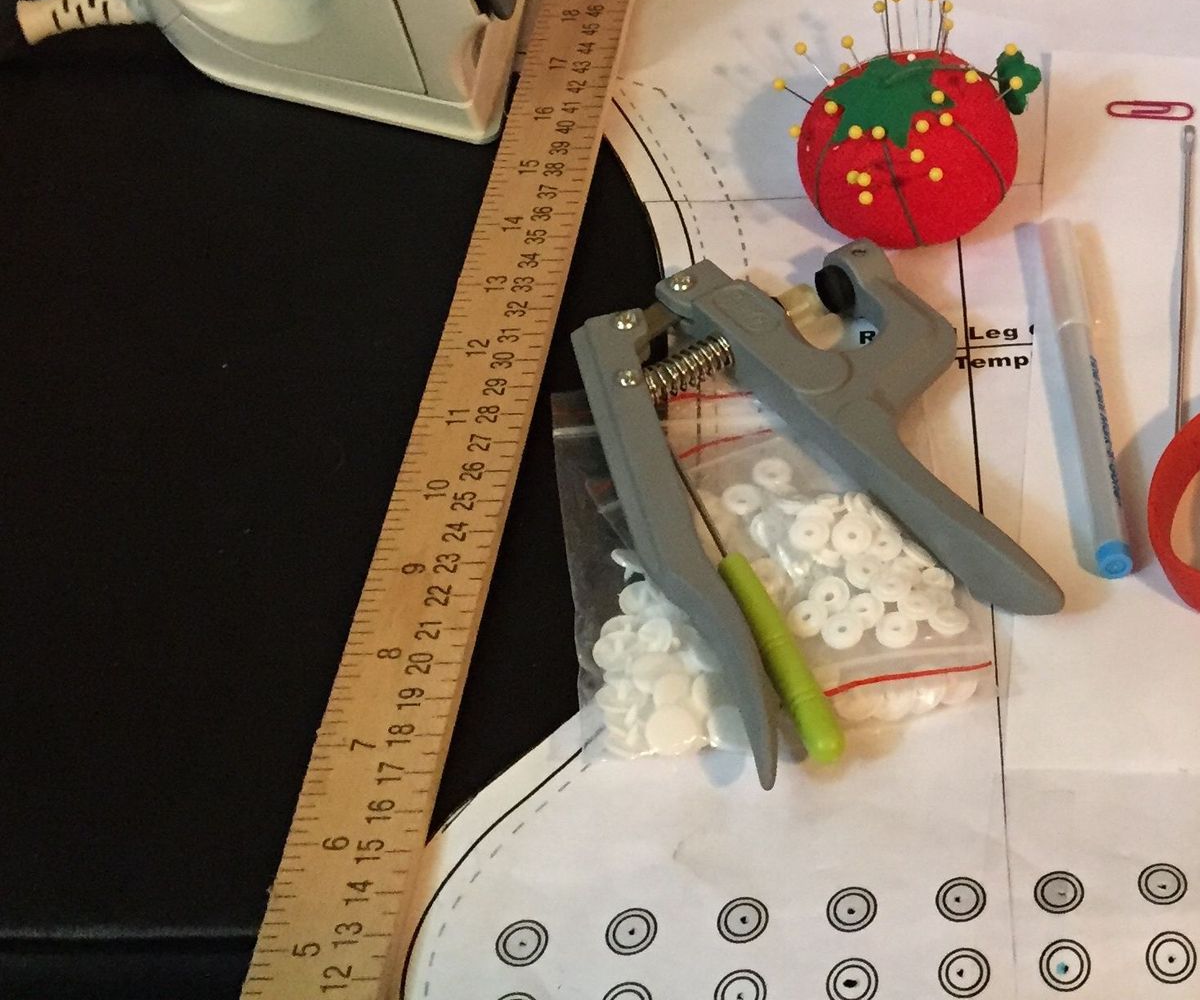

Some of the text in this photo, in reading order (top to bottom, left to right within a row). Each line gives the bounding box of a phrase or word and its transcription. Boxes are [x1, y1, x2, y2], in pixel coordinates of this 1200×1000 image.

[561, 9, 580, 22] 18
[585, 4, 605, 18] 46
[581, 23, 600, 36] 45
[576, 41, 596, 55] 44
[548, 57, 569, 70] 17
[571, 60, 592, 74] 43
[566, 79, 587, 94] 42
[534, 106, 554, 121] 16
[561, 101, 581, 114] 41
[555, 120, 576, 135] 40
[548, 140, 571, 156] 39
[517, 159, 540, 176] 15
[543, 162, 565, 177] 38
[537, 184, 559, 200] 37
[530, 206, 554, 222] 36
[501, 216, 524, 233] 14
[524, 229, 547, 245] 35
[517, 252, 540, 269] 34
[483, 275, 508, 293] 13
[511, 275, 535, 294] 33
[504, 300, 529, 318] 32
[497, 327, 521, 344] 31
[968, 326, 1019, 341] Leg
[465, 338, 490, 358] 12
[490, 351, 515, 369] 30
[483, 378, 507, 396] 29
[445, 409, 470, 426] 11
[475, 405, 500, 424] 28
[466, 433, 492, 452] 27
[459, 461, 485, 481] 26
[423, 478, 450, 501] 10
[450, 490, 477, 511] 25
[441, 521, 469, 543] 24
[401, 563, 426, 574] 9
[432, 553, 461, 574] 23
[424, 584, 452, 607] 22
[414, 621, 442, 641] 21
[377, 647, 402, 659] 8
[404, 652, 434, 675] 20
[396, 687, 425, 711] 19
[386, 723, 415, 747] 18
[350, 738, 376, 751] 7
[375, 762, 405, 785] 17
[365, 799, 395, 824] 16
[322, 836, 350, 851] 6
[354, 839, 385, 864] 15
[342, 880, 374, 905] 14
[331, 921, 363, 949] 13
[292, 942, 320, 957] 5
[320, 965, 353, 993] 12
